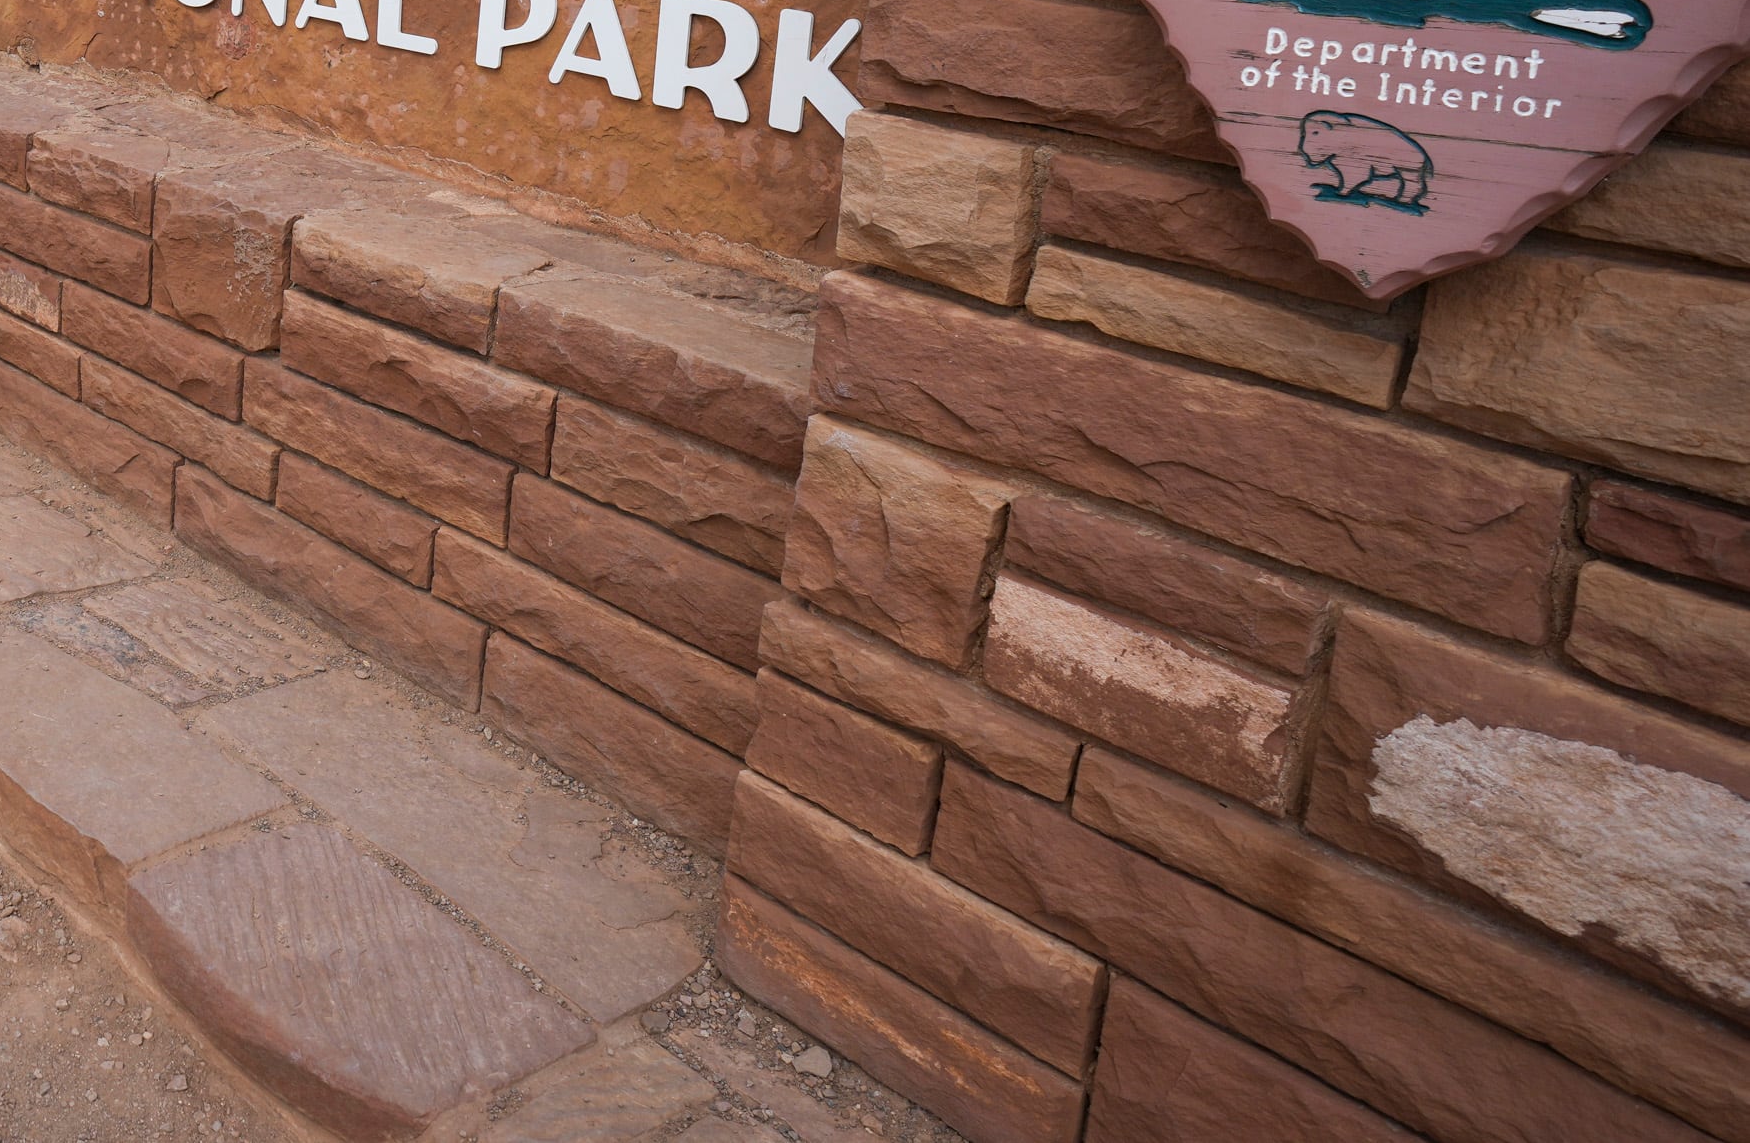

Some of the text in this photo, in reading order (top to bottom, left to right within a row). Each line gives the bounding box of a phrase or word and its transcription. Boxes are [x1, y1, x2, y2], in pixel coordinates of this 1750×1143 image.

[1265, 27, 1545, 79] Department
[1240, 59, 1562, 119] of the Interior
